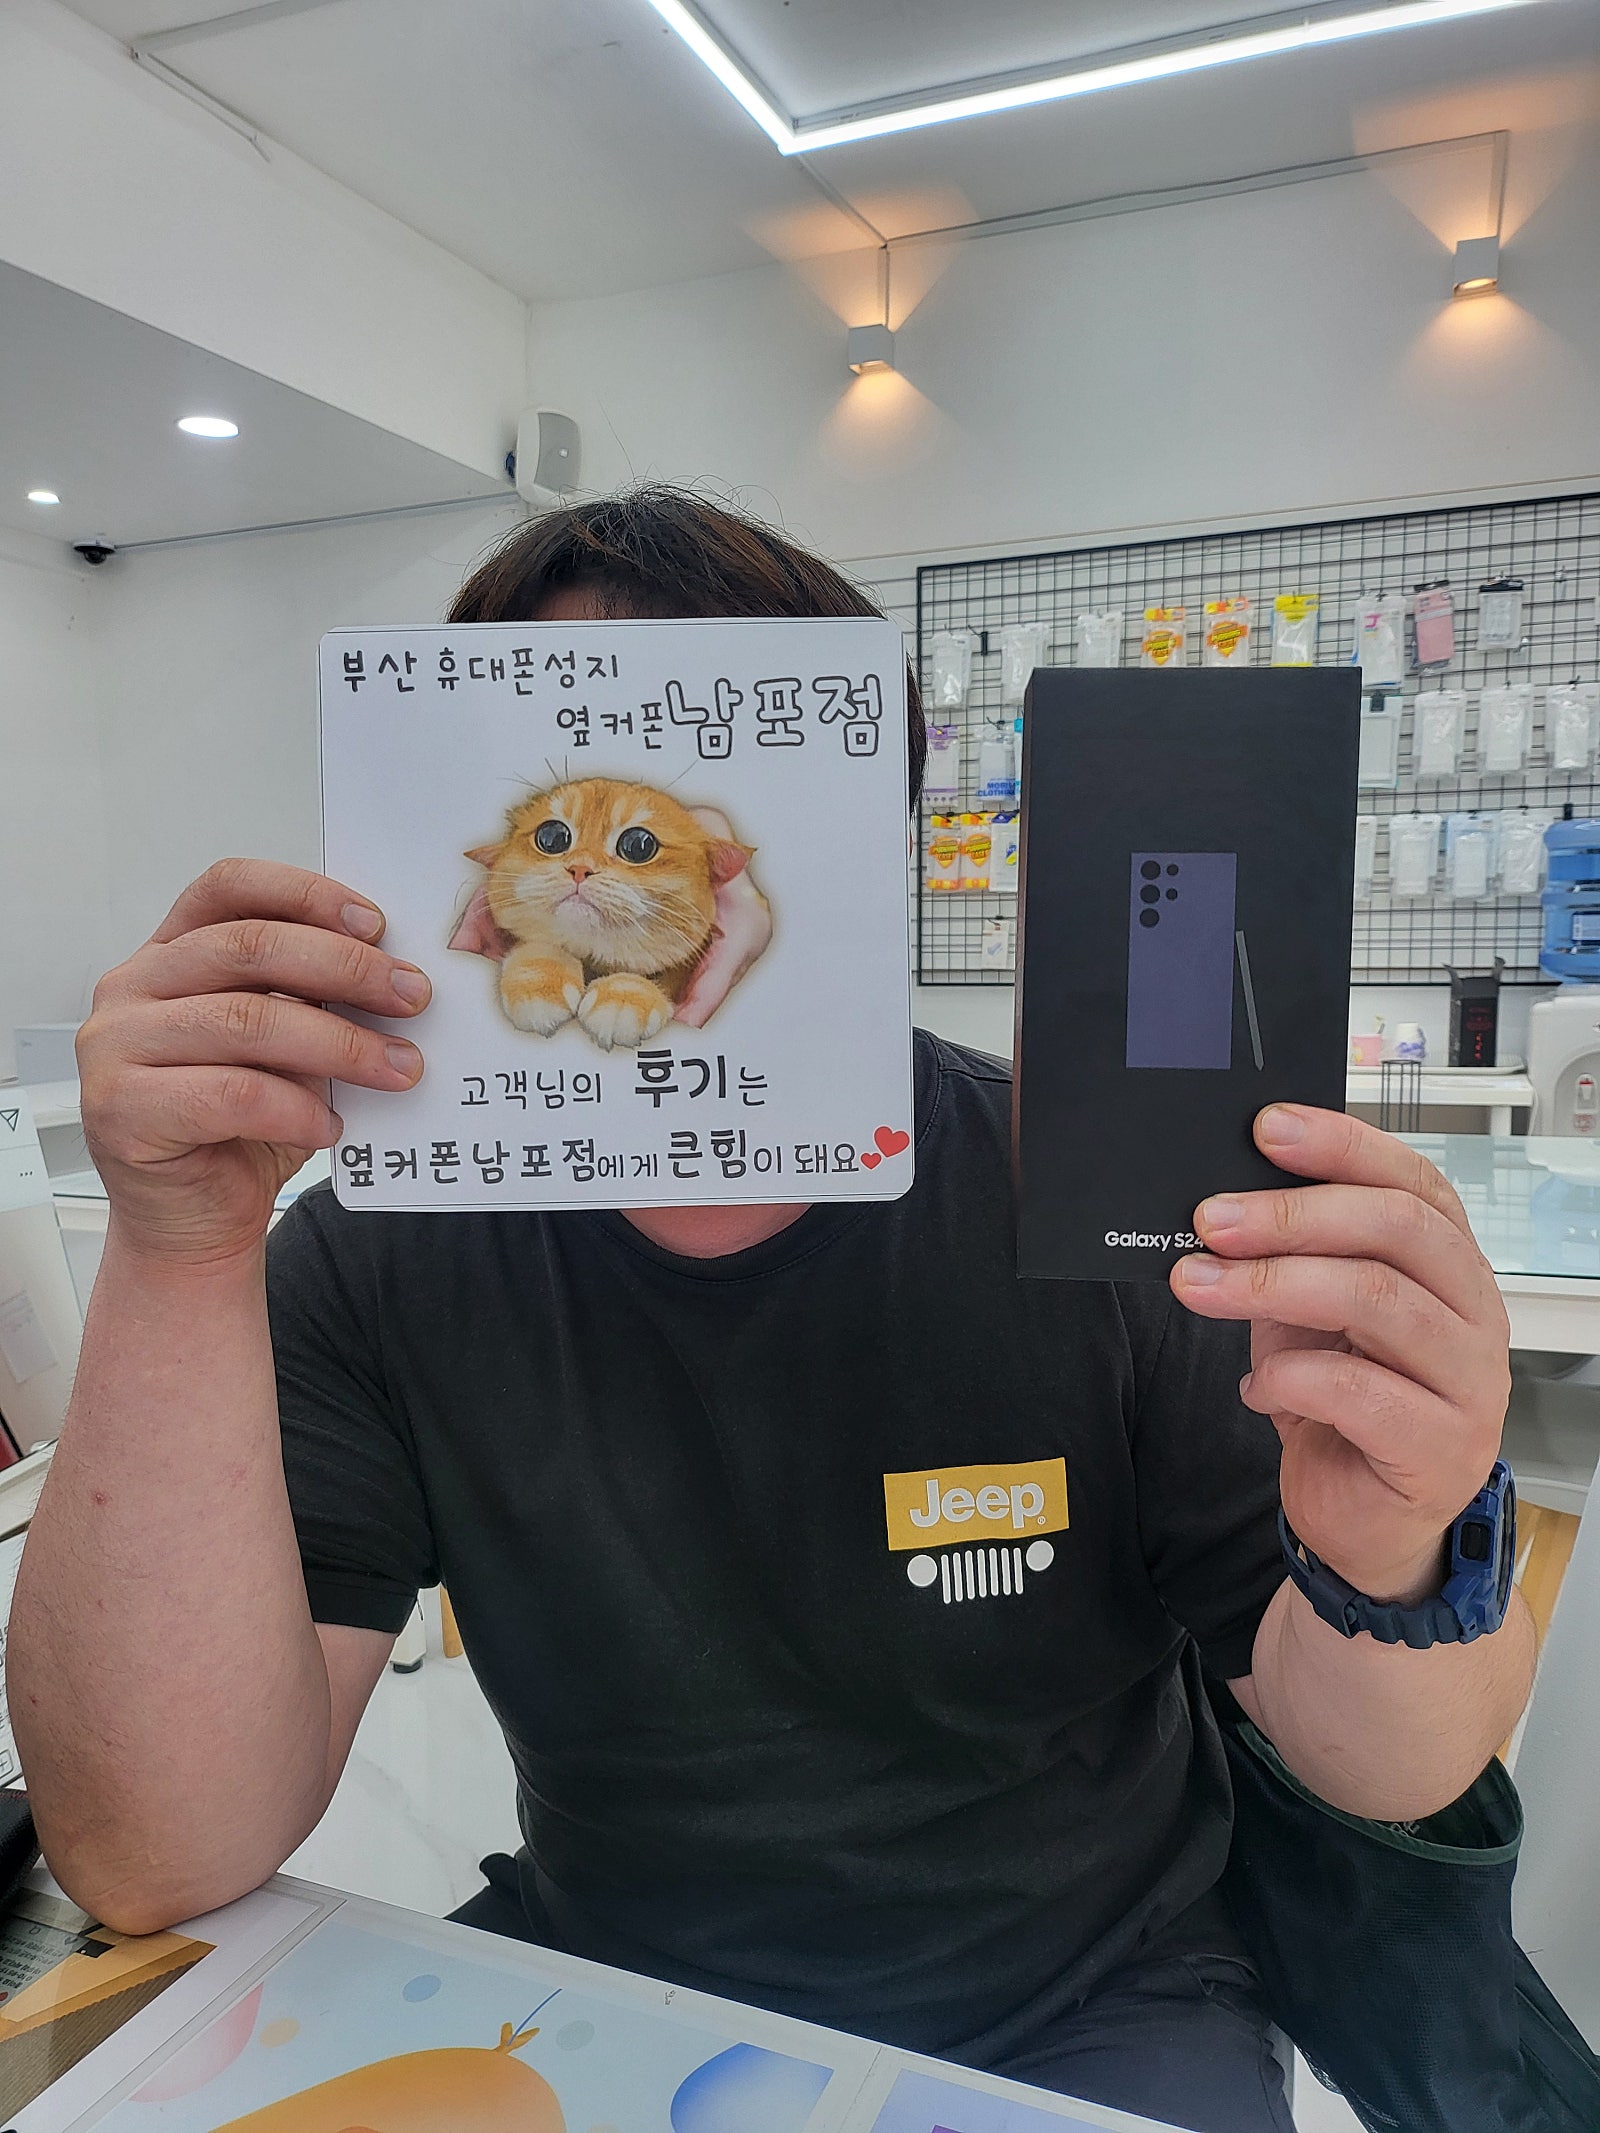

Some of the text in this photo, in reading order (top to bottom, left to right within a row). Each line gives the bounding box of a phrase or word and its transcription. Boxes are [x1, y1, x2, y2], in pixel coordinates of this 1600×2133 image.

[343, 646, 619, 696] 부산 휴대폰성지
[556, 673, 883, 760] 옆커폰 남포점
[460, 1049, 769, 1110] 고객님의 후기는
[794, 1143, 859, 1174] 돼요
[1104, 1231, 1172, 1252] Galaxy
[909, 1478, 1045, 1529] Jeep
